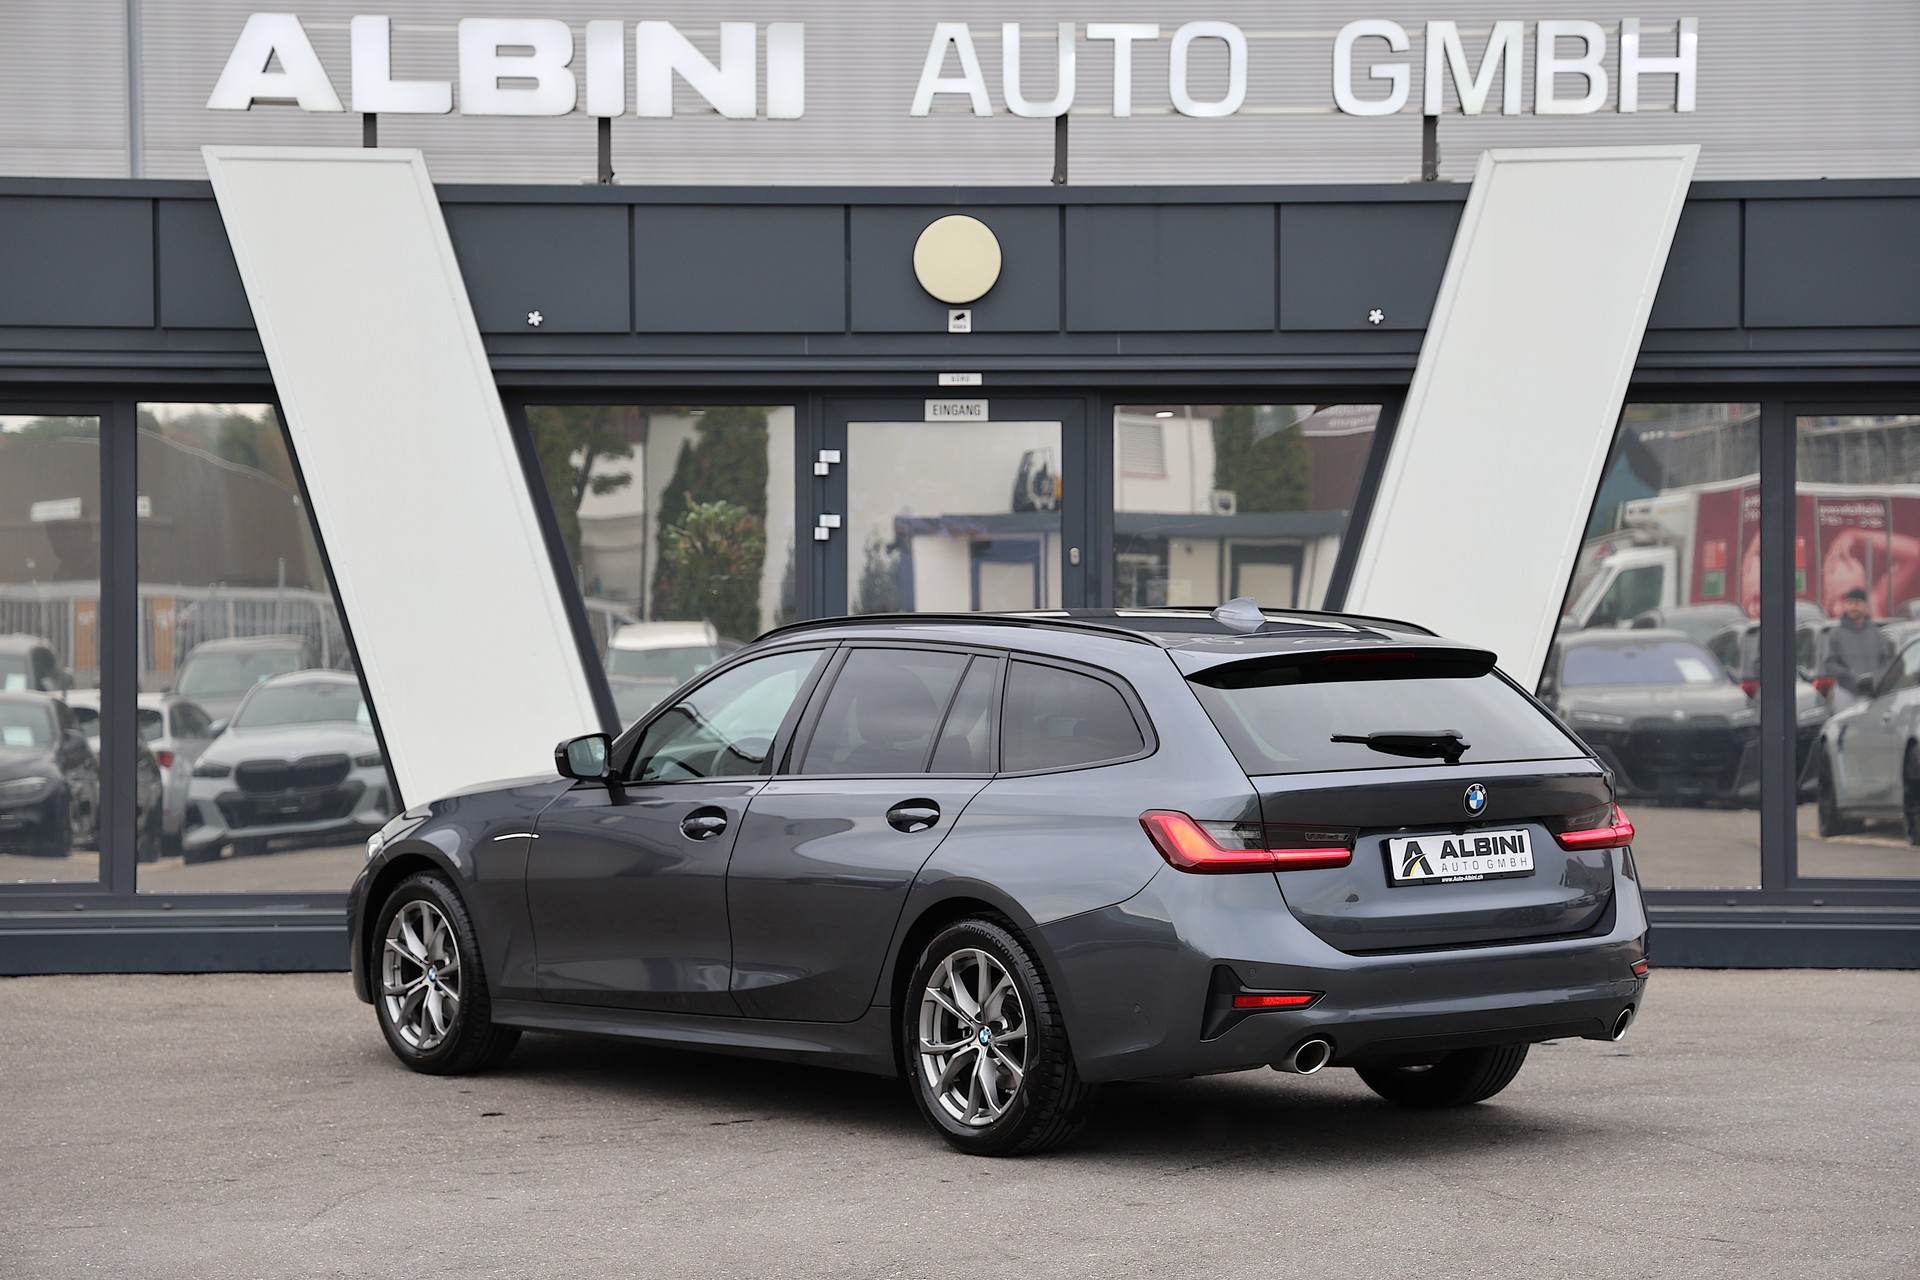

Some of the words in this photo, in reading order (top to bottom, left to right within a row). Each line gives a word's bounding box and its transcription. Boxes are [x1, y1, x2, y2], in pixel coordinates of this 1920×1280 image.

[205, 12, 805, 119] ALBINI
[909, 21, 1249, 118] AUTO
[1330, 17, 1700, 117] GMBH
[932, 404, 981, 416] EINGANG
[1440, 835, 1525, 859] ALBINI
[1442, 860, 1480, 872] AUTO
[1487, 857, 1527, 869] GMBH
[1441, 874, 1484, 883] www.Auto-Albini.ch
